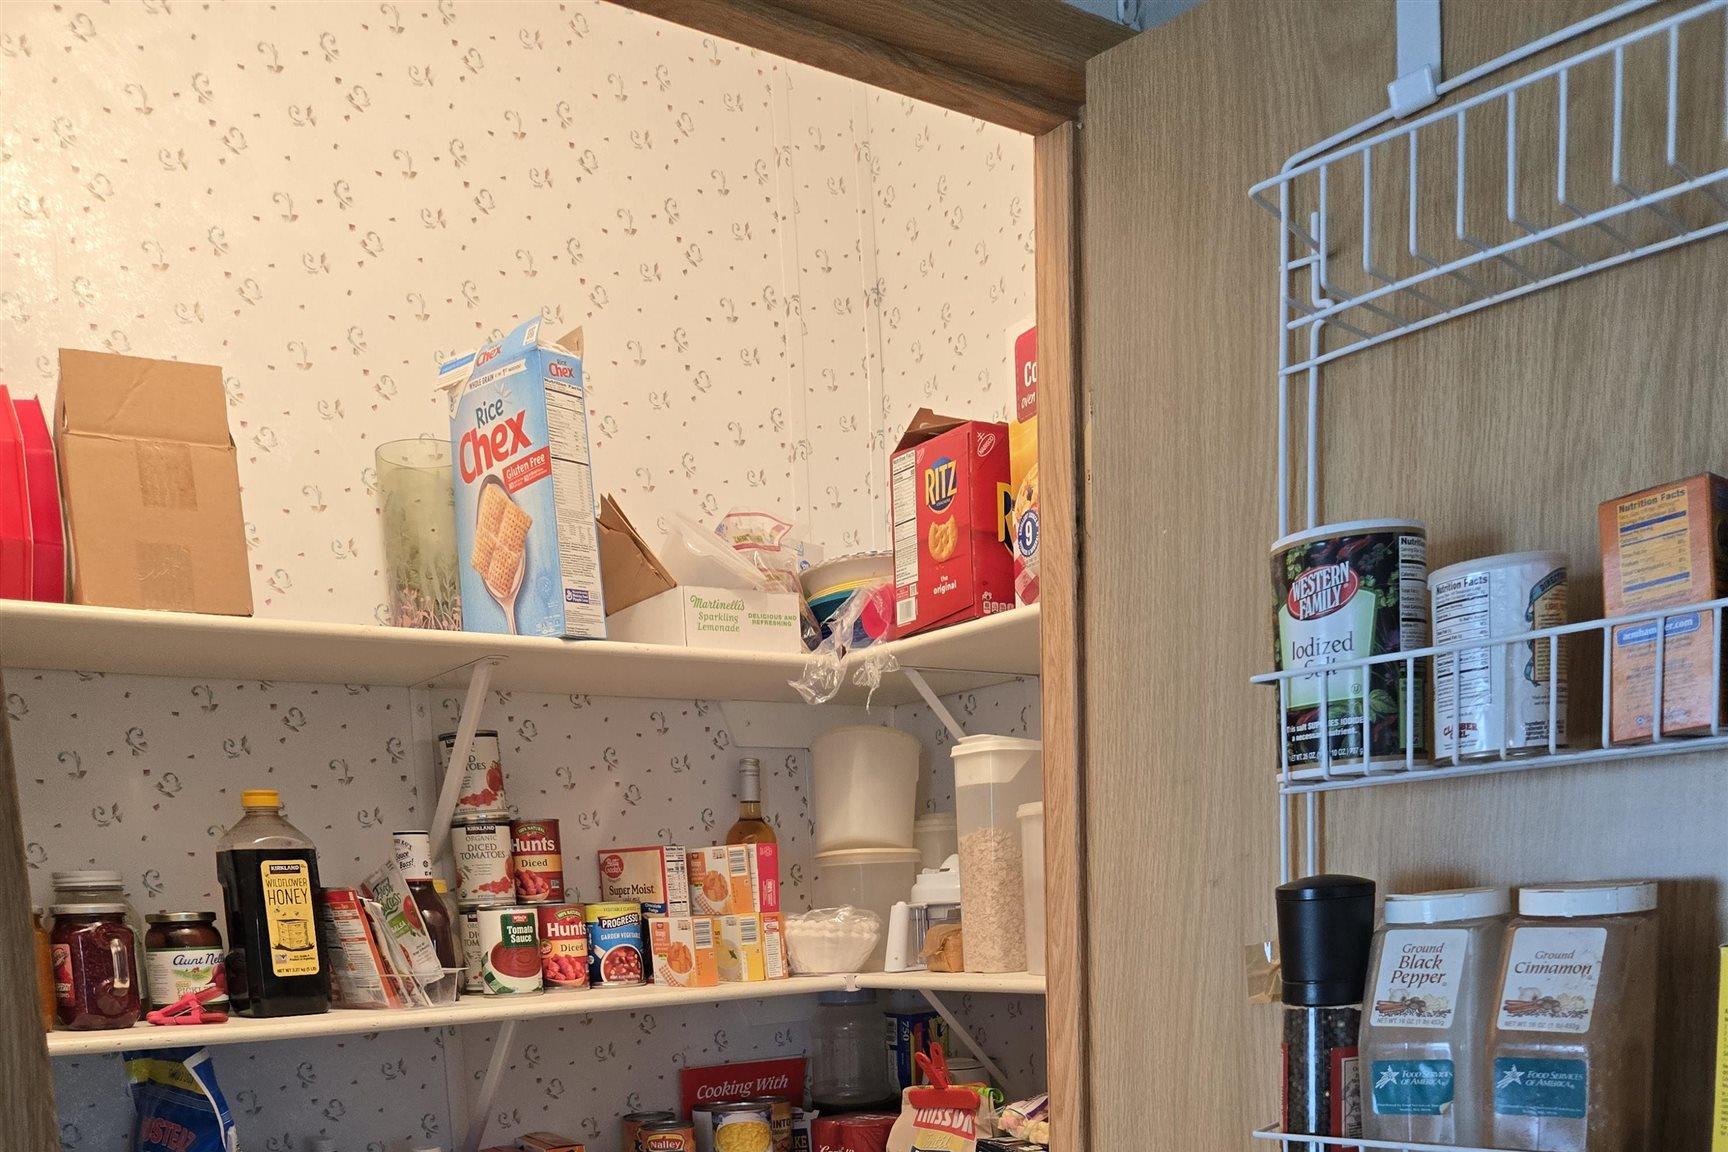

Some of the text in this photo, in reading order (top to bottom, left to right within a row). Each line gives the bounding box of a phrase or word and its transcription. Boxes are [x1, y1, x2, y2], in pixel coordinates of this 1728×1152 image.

[549, 362, 575, 378] Chex
[475, 399, 503, 429] Rice
[459, 410, 532, 484] Chex
[507, 461, 529, 480] Gluten
[530, 453, 545, 468] Free
[924, 459, 957, 506] RITZ
[1618, 489, 1686, 513] Nutrition Facts
[933, 580, 957, 595] original
[1292, 561, 1350, 601] WESTERN
[1463, 576, 1488, 588] Facts
[1300, 585, 1343, 620] FAMILY
[698, 612, 738, 625] Sparkling
[748, 613, 782, 621] DELICIOUS
[752, 619, 792, 627] REFRESHING
[697, 622, 740, 632] Lemonade
[1622, 618, 1694, 641] armhamer.com
[1292, 631, 1354, 661] Iodized
[468, 843, 497, 852] DICED
[461, 851, 506, 860] TOMATOES
[521, 858, 548, 867] Diced
[266, 877, 307, 888] WILDFLOWER
[608, 882, 655, 898] Super Moist
[267, 888, 308, 906] HONEY
[602, 913, 639, 929] PROGRESSO
[507, 925, 534, 936] Tomato
[511, 933, 532, 943] Sauce
[560, 943, 584, 952] Diced
[1402, 942, 1446, 954] Ground
[1535, 949, 1576, 960] Ground
[173, 954, 203, 966] Aunt
[1398, 954, 1443, 969] Black
[1514, 961, 1593, 976] Cinnamon
[1390, 969, 1447, 988] Pepper
[697, 1074, 788, 1100] Cooking With
[650, 1140, 681, 1150] Nalley
